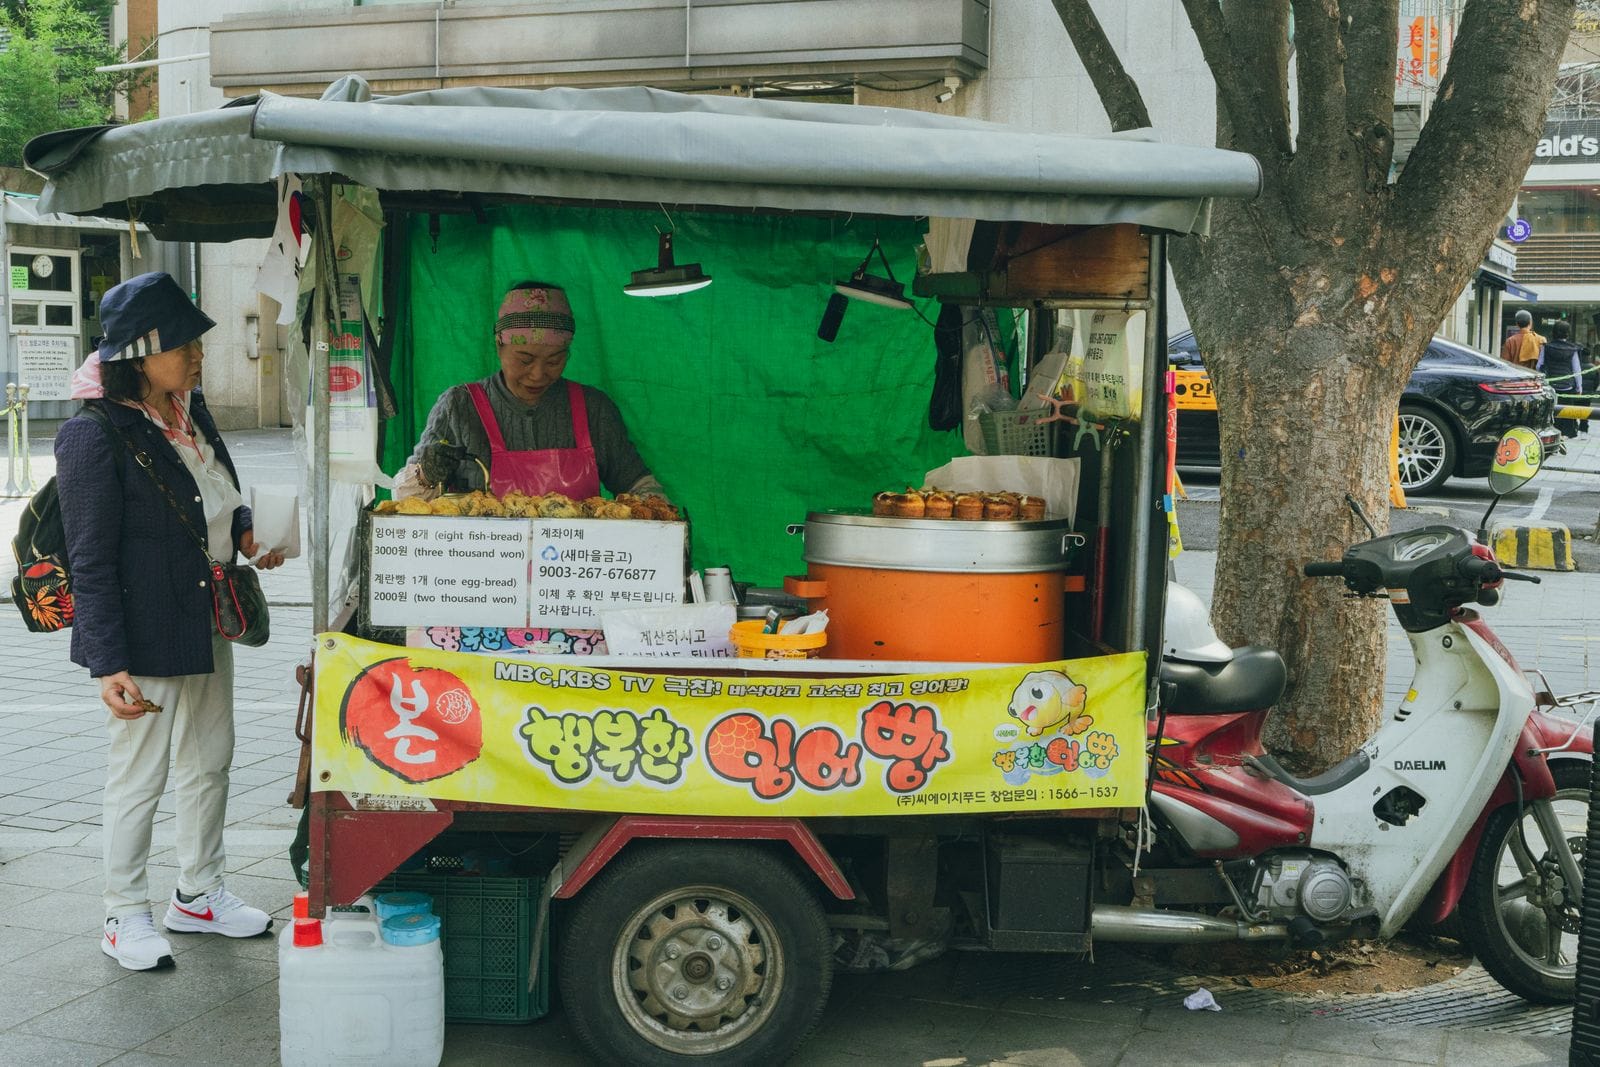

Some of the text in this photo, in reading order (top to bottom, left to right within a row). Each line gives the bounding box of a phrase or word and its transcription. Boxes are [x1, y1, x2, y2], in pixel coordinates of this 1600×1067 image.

[375, 527, 523, 542] 잉어빵 8개 (eight fish-bread)
[541, 527, 585, 540] 계좌이체
[374, 545, 525, 560] 3000원 (three thousand won)
[560, 548, 633, 564] (새마을금고)
[539, 565, 656, 581] 9003-267-676877
[374, 573, 517, 589] 계란빵 1개 (one egg-bread)
[374, 591, 517, 605] 2000원 (two thousand won)
[539, 588, 677, 603] 이체 후 확인 부탁드립니다.
[538, 604, 596, 617] 감사합니다.
[639, 629, 707, 646] 계산하시고
[494, 661, 969, 698] MBC,KBS TV 극찬! 바삭하고 고소한 최고 잉어빵!
[519, 701, 951, 800] 행복한 잉어빵
[1394, 760, 1446, 771] DAELIM
[990, 788, 1037, 803] 창업문의
[1048, 786, 1119, 801] 1566-1537
